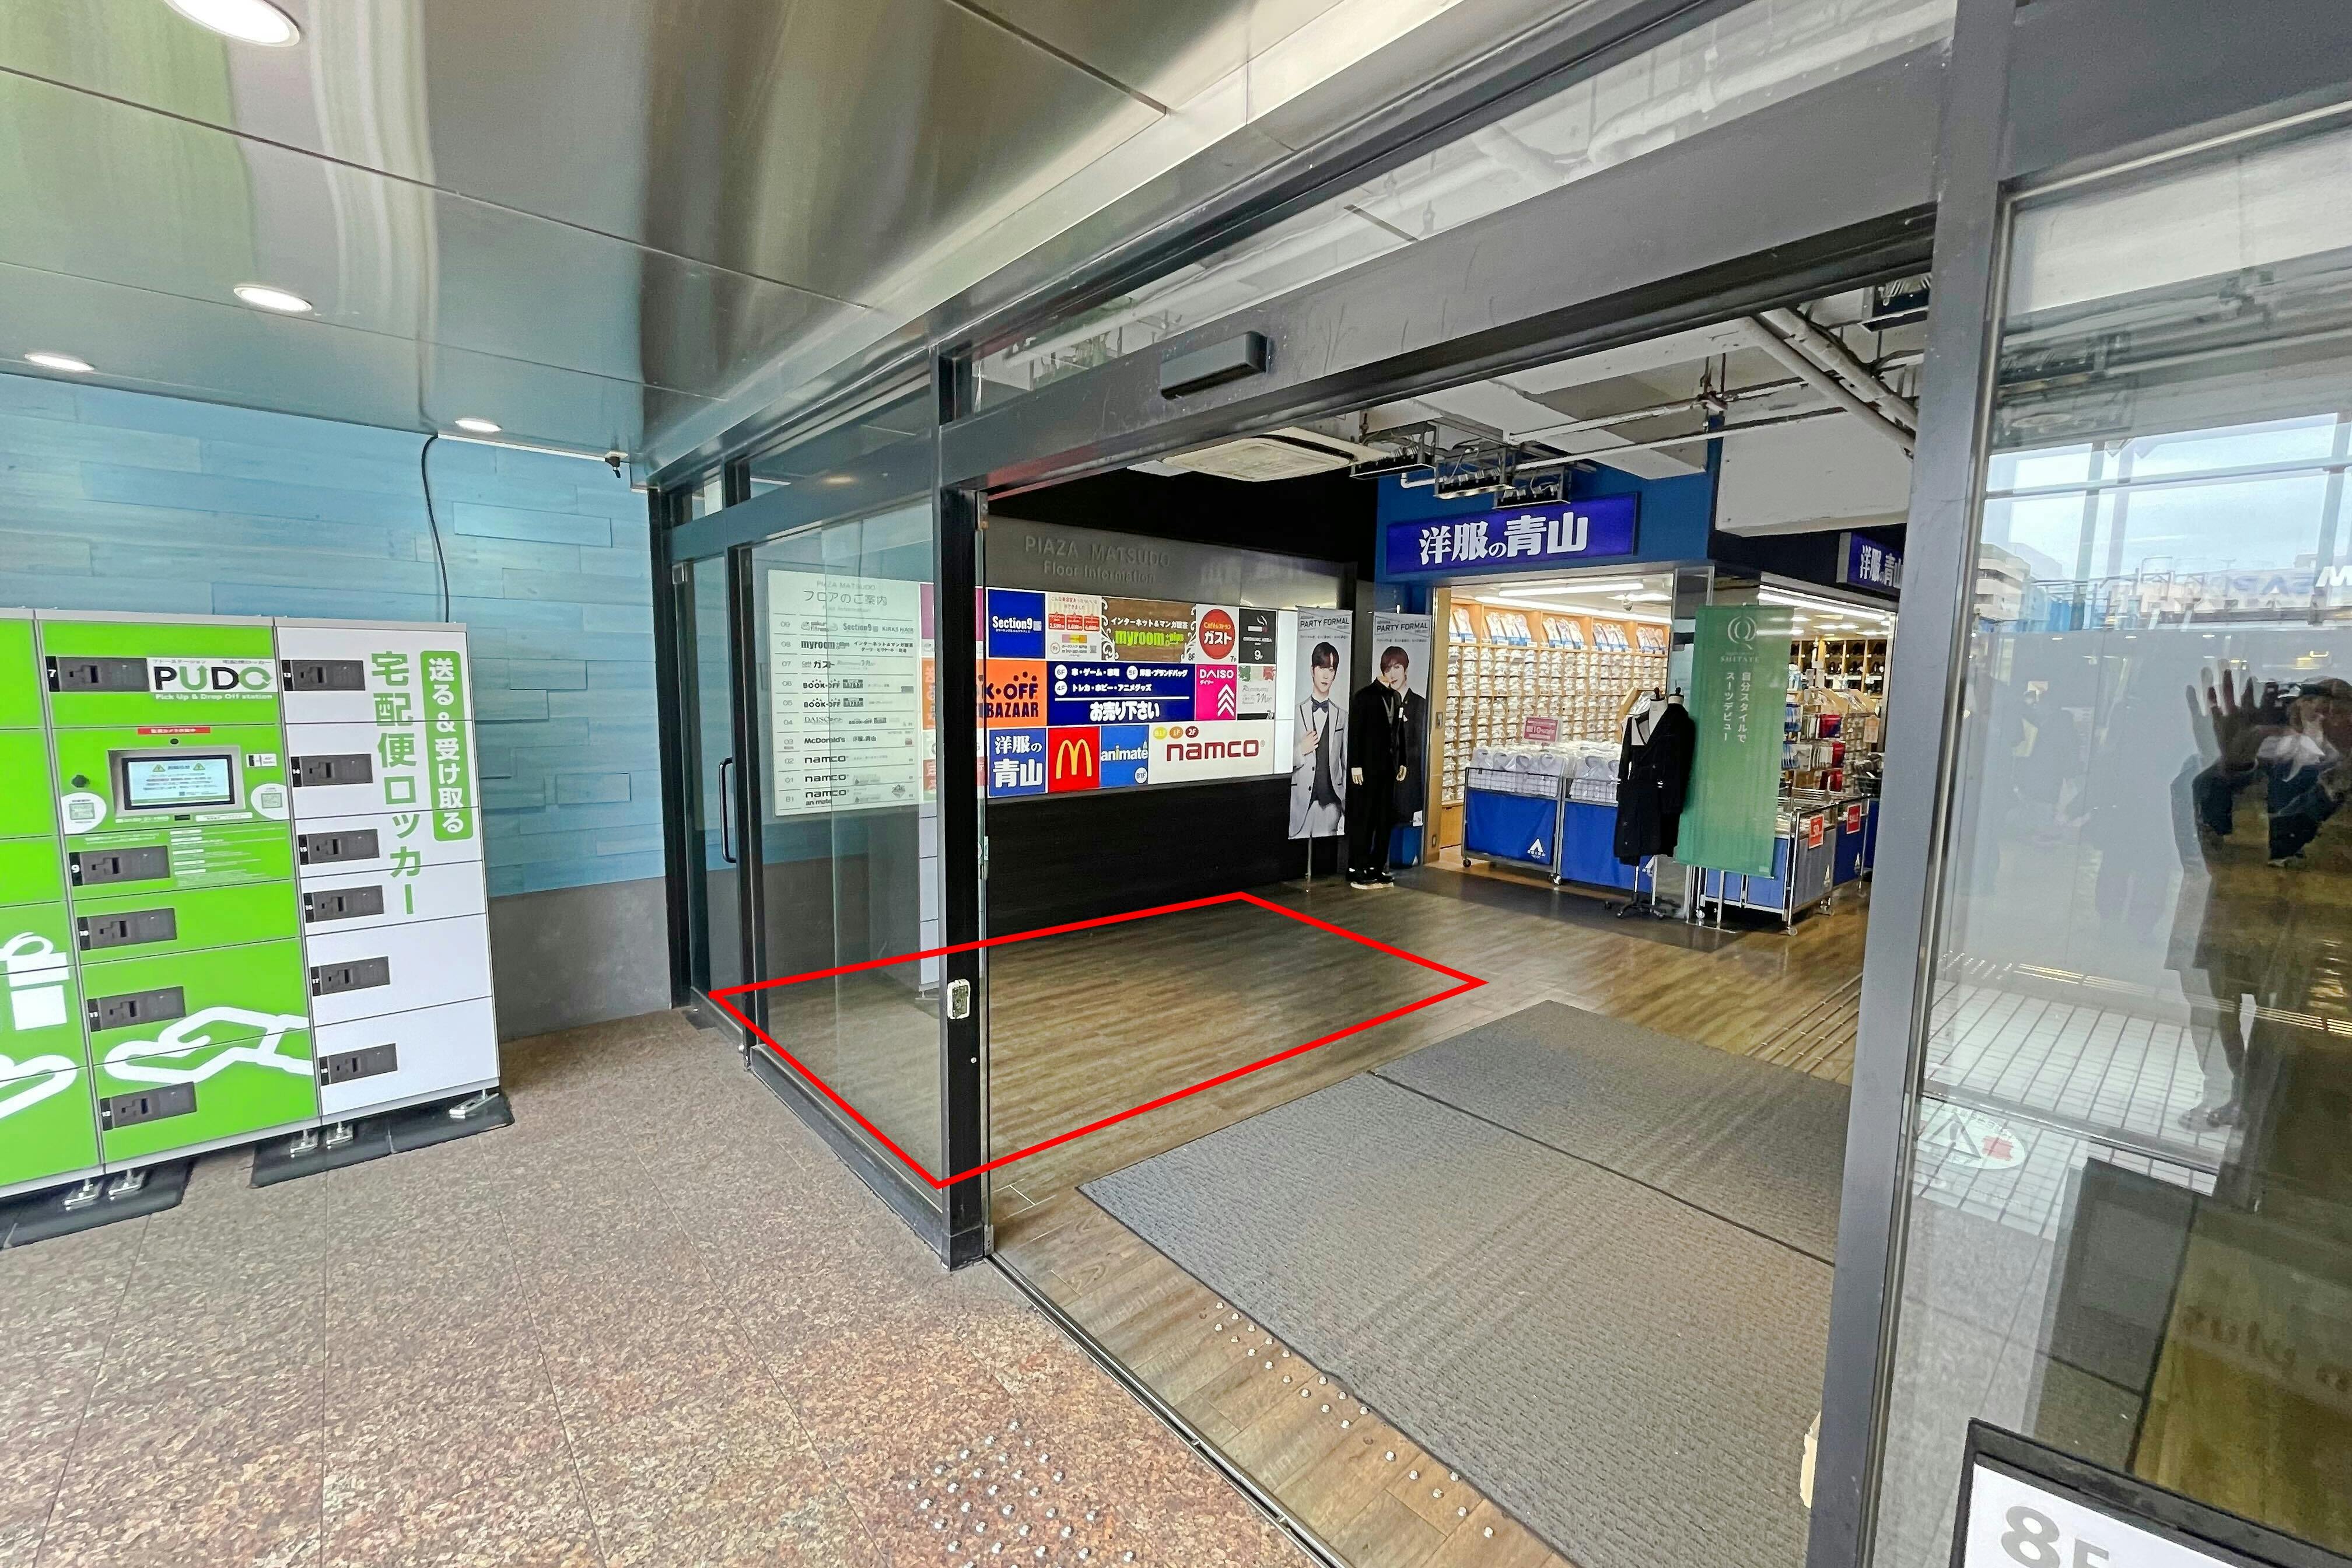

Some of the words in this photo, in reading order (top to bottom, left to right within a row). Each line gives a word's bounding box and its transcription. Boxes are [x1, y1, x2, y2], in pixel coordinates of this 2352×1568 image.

[1419, 512, 1588, 565] 洋服の青山
[1091, 544, 1170, 566] MATSUDO
[1044, 560, 1079, 577] Floor
[1084, 565, 1156, 583] Information
[803, 590, 887, 606] フロアのご案内
[843, 623, 872, 632] Section9
[992, 615, 1032, 629] Section9
[1300, 619, 1322, 628] PARTY
[1324, 618, 1349, 626] FORMAL
[1377, 624, 1398, 632] PARTY
[801, 640, 835, 649] myroom
[1115, 630, 1165, 646] myroom
[1203, 631, 1233, 645] ガスト
[48, 670, 55, 678] 7
[154, 665, 273, 691] PUDO
[1199, 668, 1234, 678] DAISO
[986, 702, 1038, 718] BAZAAR
[1090, 701, 1160, 722] お売り下さい
[1724, 672, 1735, 741] スーツデビュー
[1738, 672, 1751, 743] 自分スタイルで
[1188, 728, 1197, 736] 2F
[429, 658, 464, 833] 送る&受け取る
[995, 736, 1042, 755] 洋服の
[1101, 741, 1149, 762] animate
[1167, 740, 1258, 761] namco
[804, 755, 846, 764] namco
[805, 774, 846, 782] namco
[992, 758, 1043, 788] 青山
[372, 651, 421, 915] 宅配便ロッカー
[806, 789, 846, 798] namco
[72, 864, 80, 873] 9
